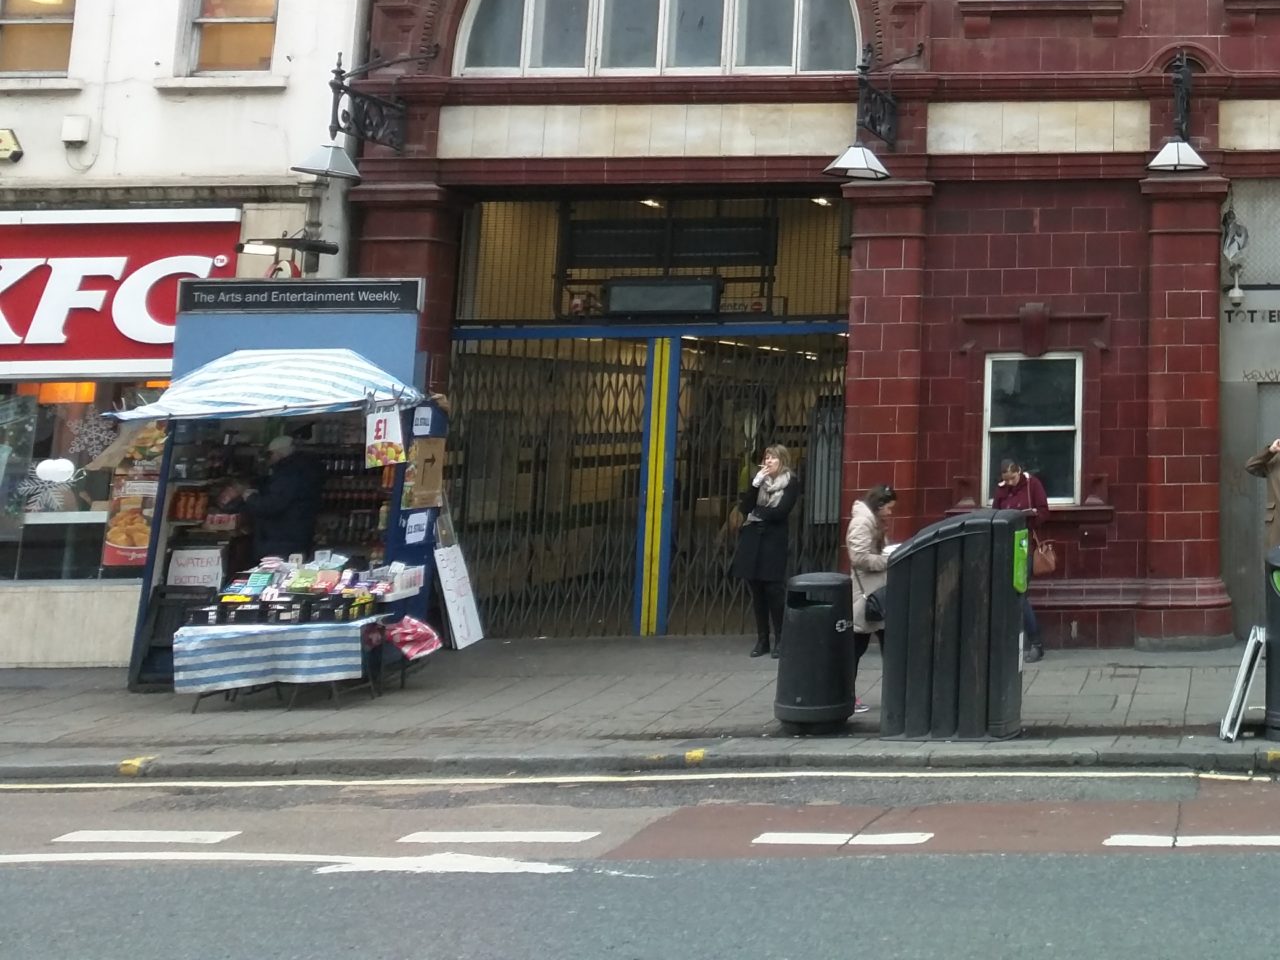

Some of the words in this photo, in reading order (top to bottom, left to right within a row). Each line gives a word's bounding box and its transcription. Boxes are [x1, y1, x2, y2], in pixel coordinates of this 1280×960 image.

[192, 291, 215, 303] The
[217, 291, 242, 303] Arts
[244, 291, 268, 302] and
[271, 291, 354, 302] Entertainment
[373, 418, 388, 441] £1
